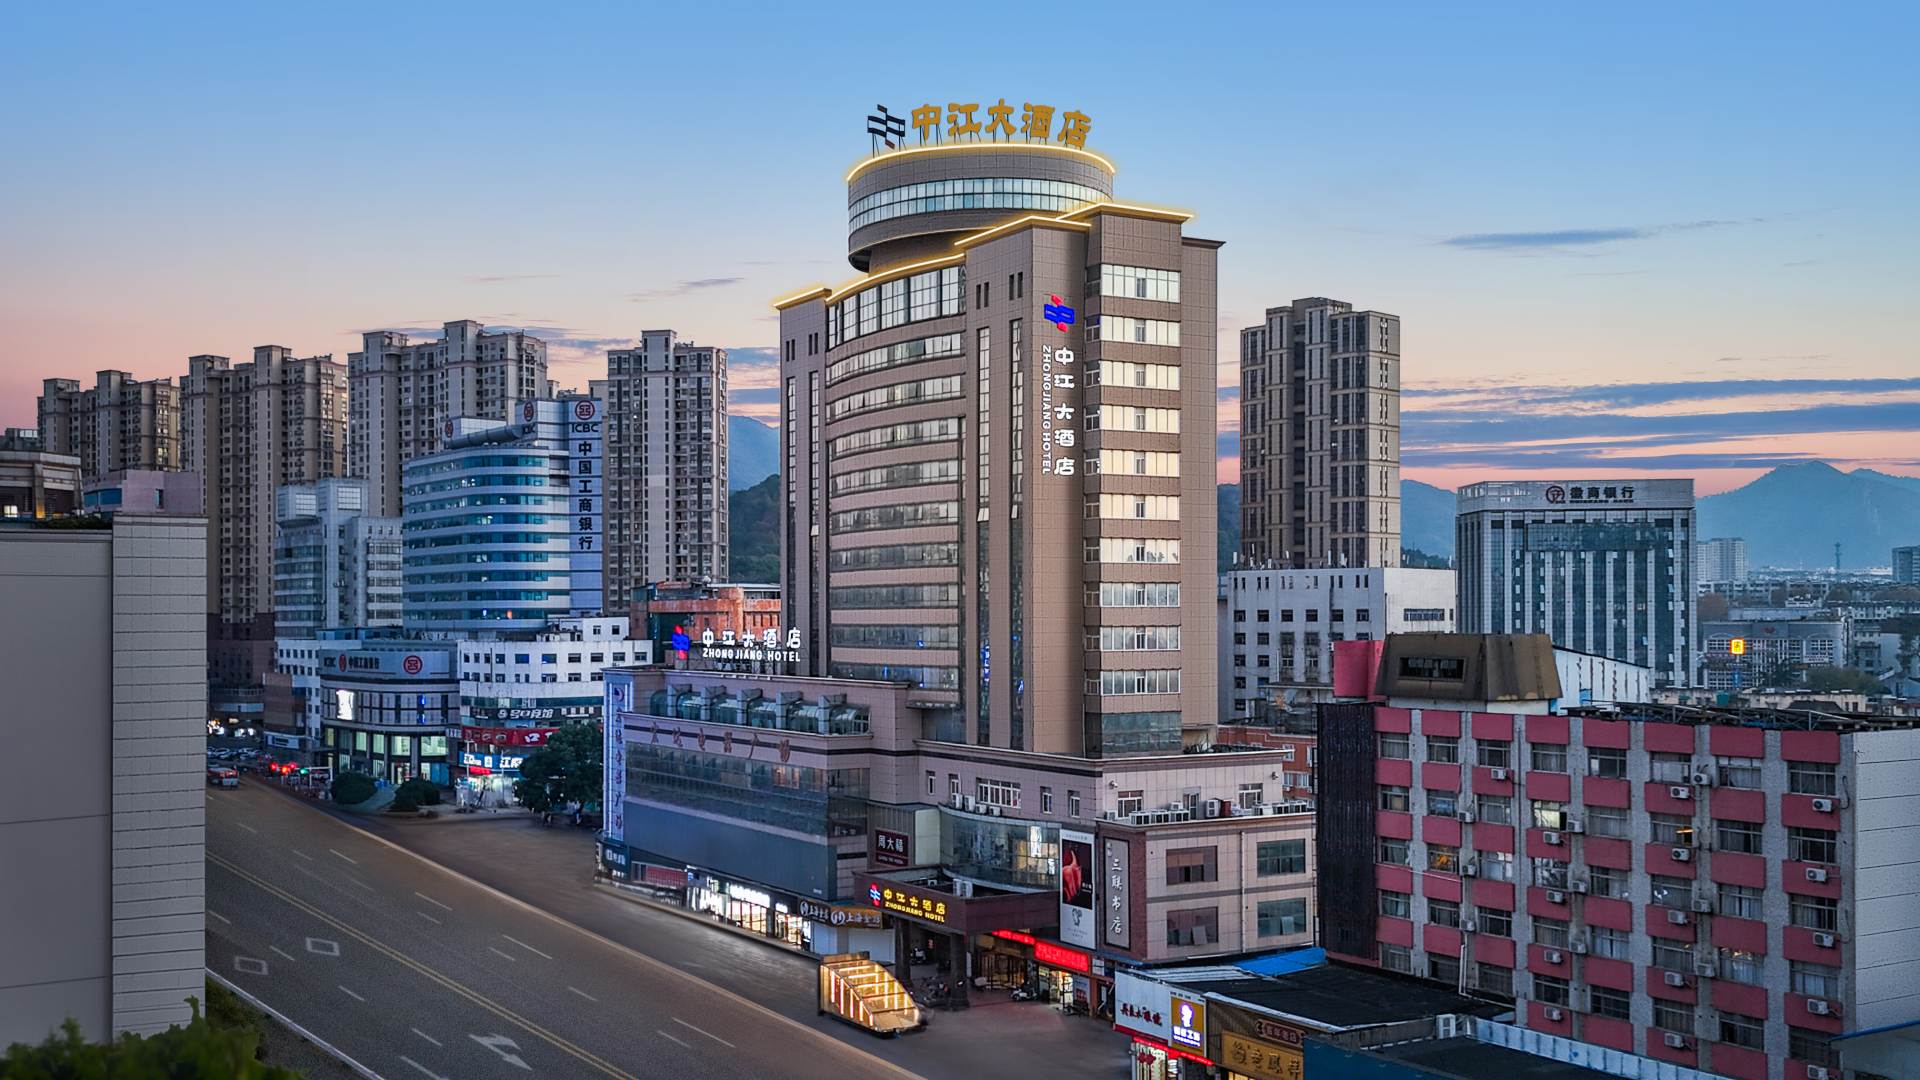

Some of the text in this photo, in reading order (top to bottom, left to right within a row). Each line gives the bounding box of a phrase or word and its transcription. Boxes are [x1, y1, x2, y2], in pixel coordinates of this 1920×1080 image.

[911, 98, 1092, 148] 中江大酒店
[571, 423, 599, 433] ICBC
[1054, 347, 1075, 476] 中江大酒店
[1042, 432, 1052, 474] HOTEL
[578, 440, 593, 550] 中国工商银行
[702, 627, 801, 648] 中江大酒店
[767, 651, 801, 662] HOTEL
[883, 888, 946, 915] 中江大酒店
[1110, 858, 1122, 934] 三联书店
[925, 911, 945, 923] HOTEL
